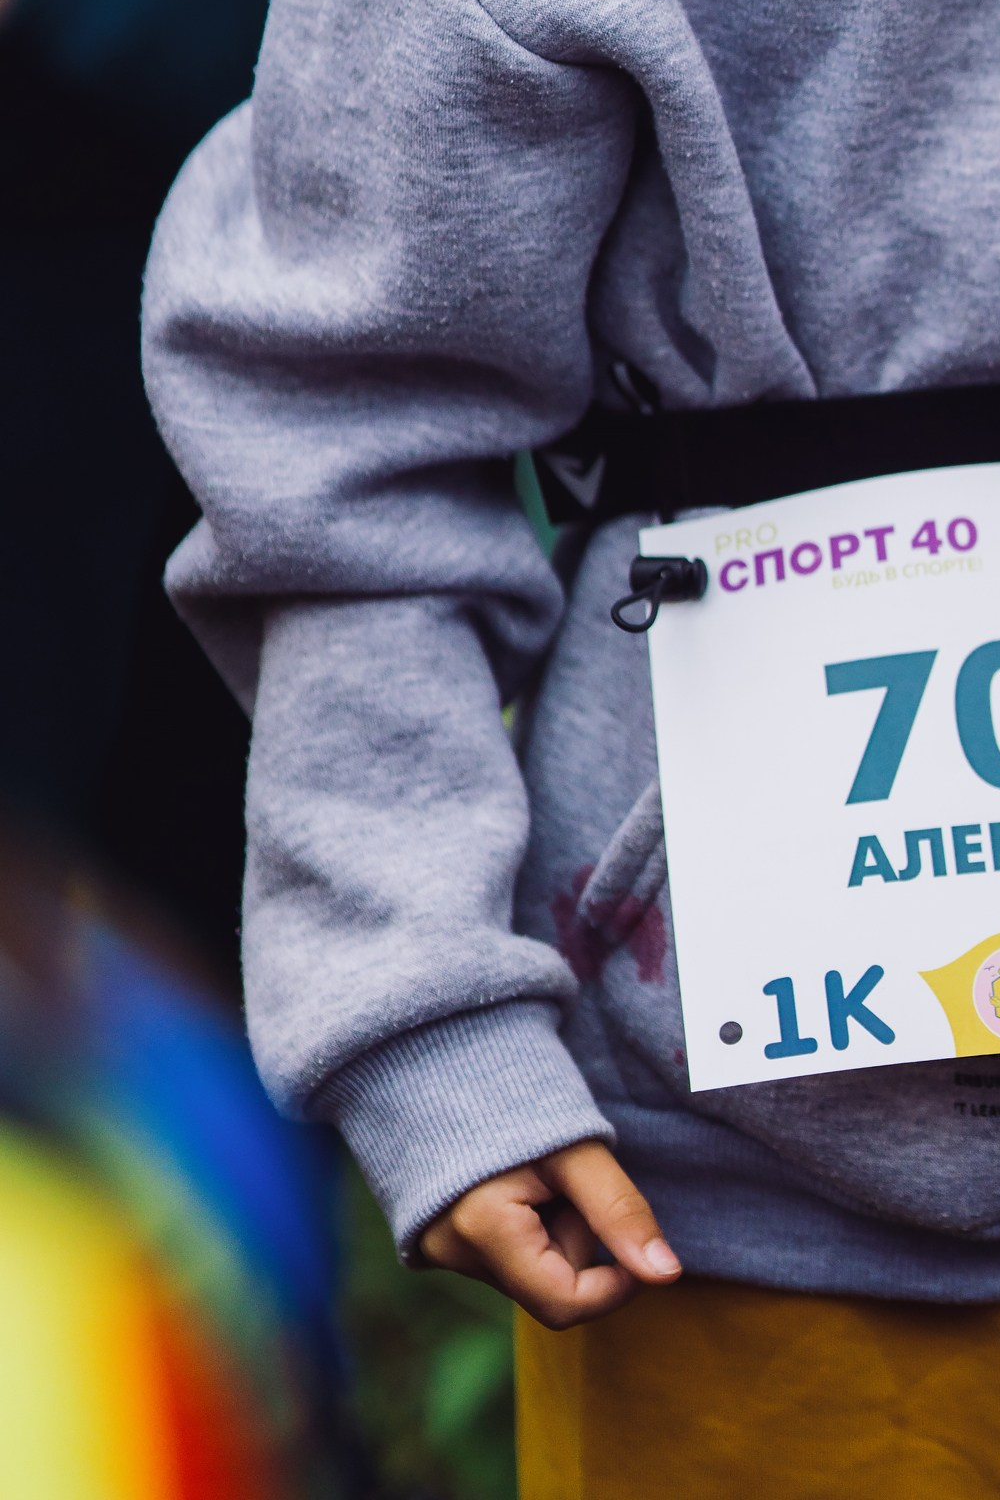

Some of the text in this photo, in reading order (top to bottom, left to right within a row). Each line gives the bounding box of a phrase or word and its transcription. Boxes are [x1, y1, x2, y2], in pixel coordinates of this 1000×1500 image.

[714, 522, 779, 556] PRO
[719, 517, 979, 593] СПОРТ 40
[831, 567, 881, 590] БУДЬ
[885, 562, 898, 581] В
